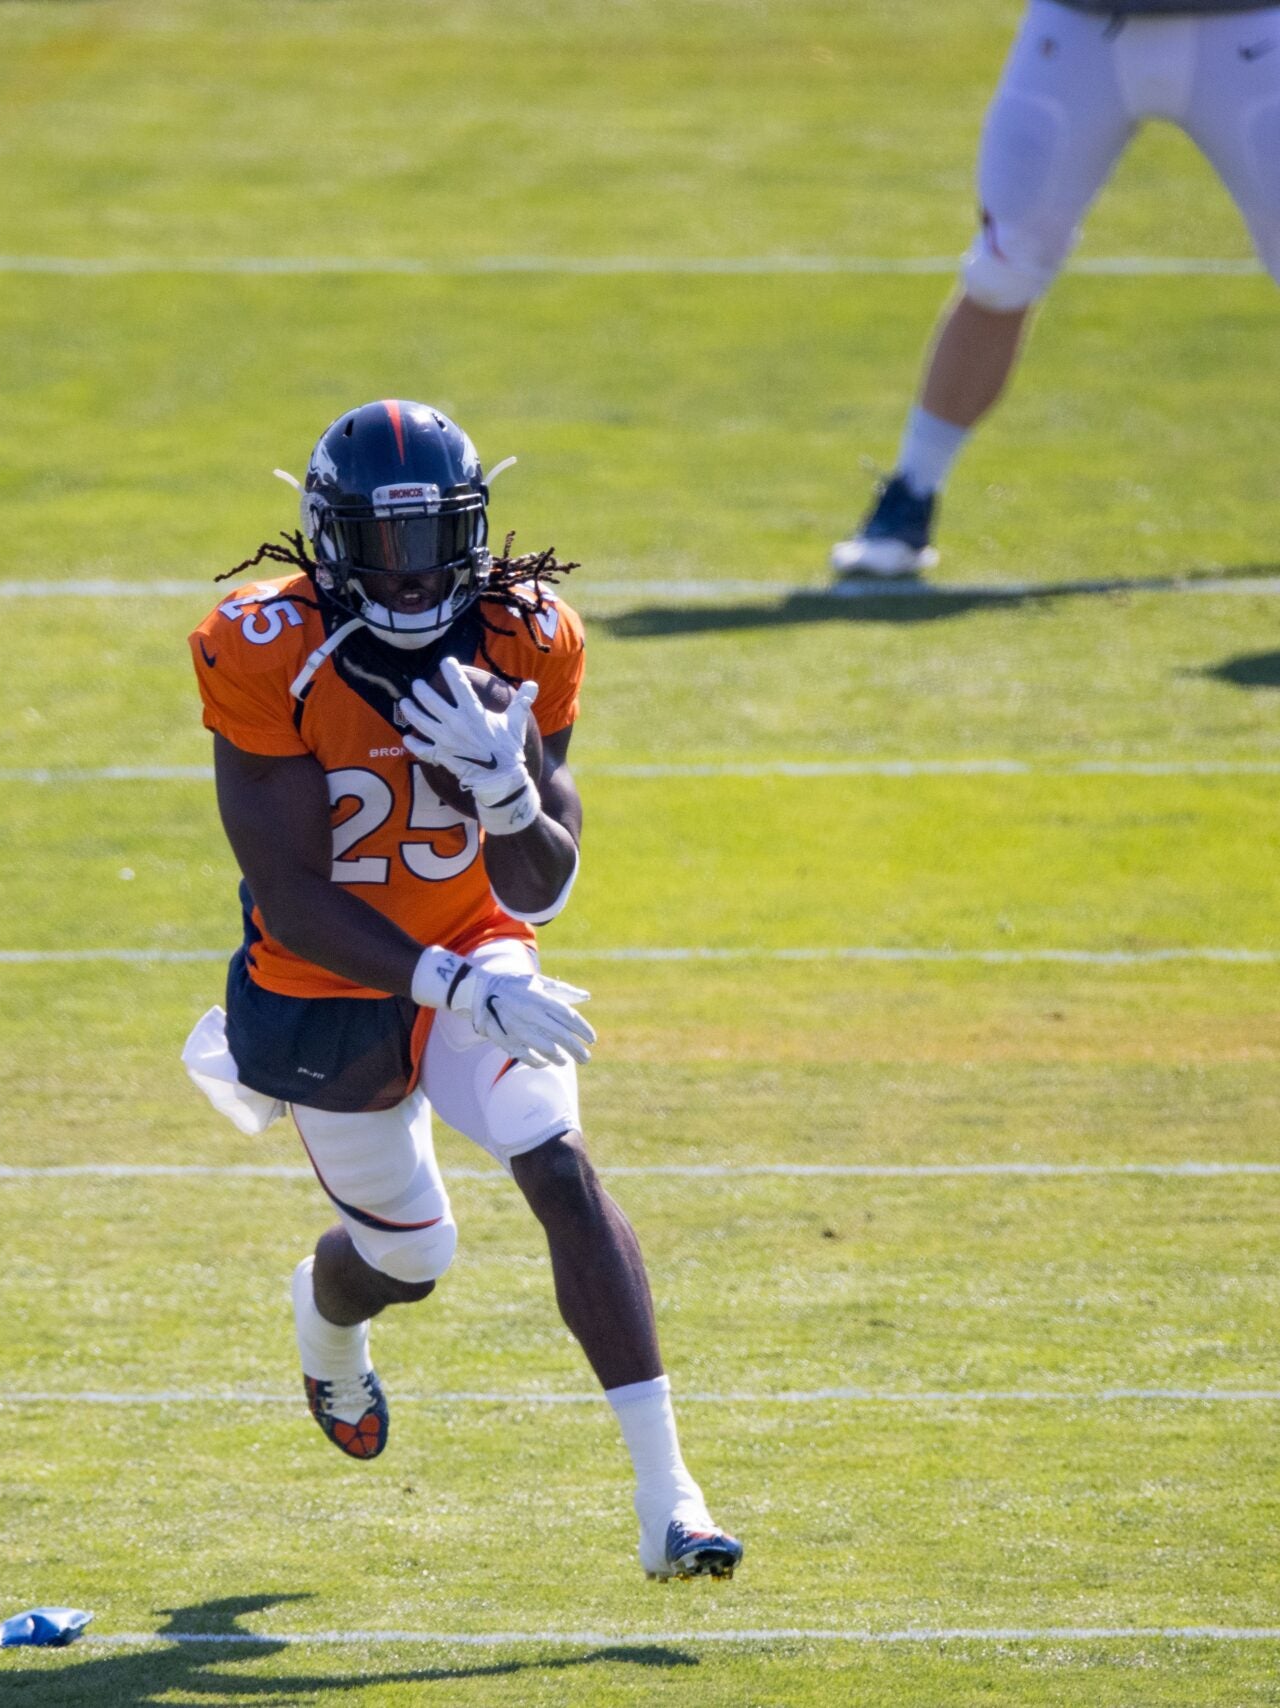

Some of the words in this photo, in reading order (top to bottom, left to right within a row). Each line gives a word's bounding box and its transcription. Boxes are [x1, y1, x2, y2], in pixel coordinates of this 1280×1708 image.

[388, 487, 423, 499] BRONCOS
[218, 584, 304, 645] 25
[326, 764, 479, 883] 25
